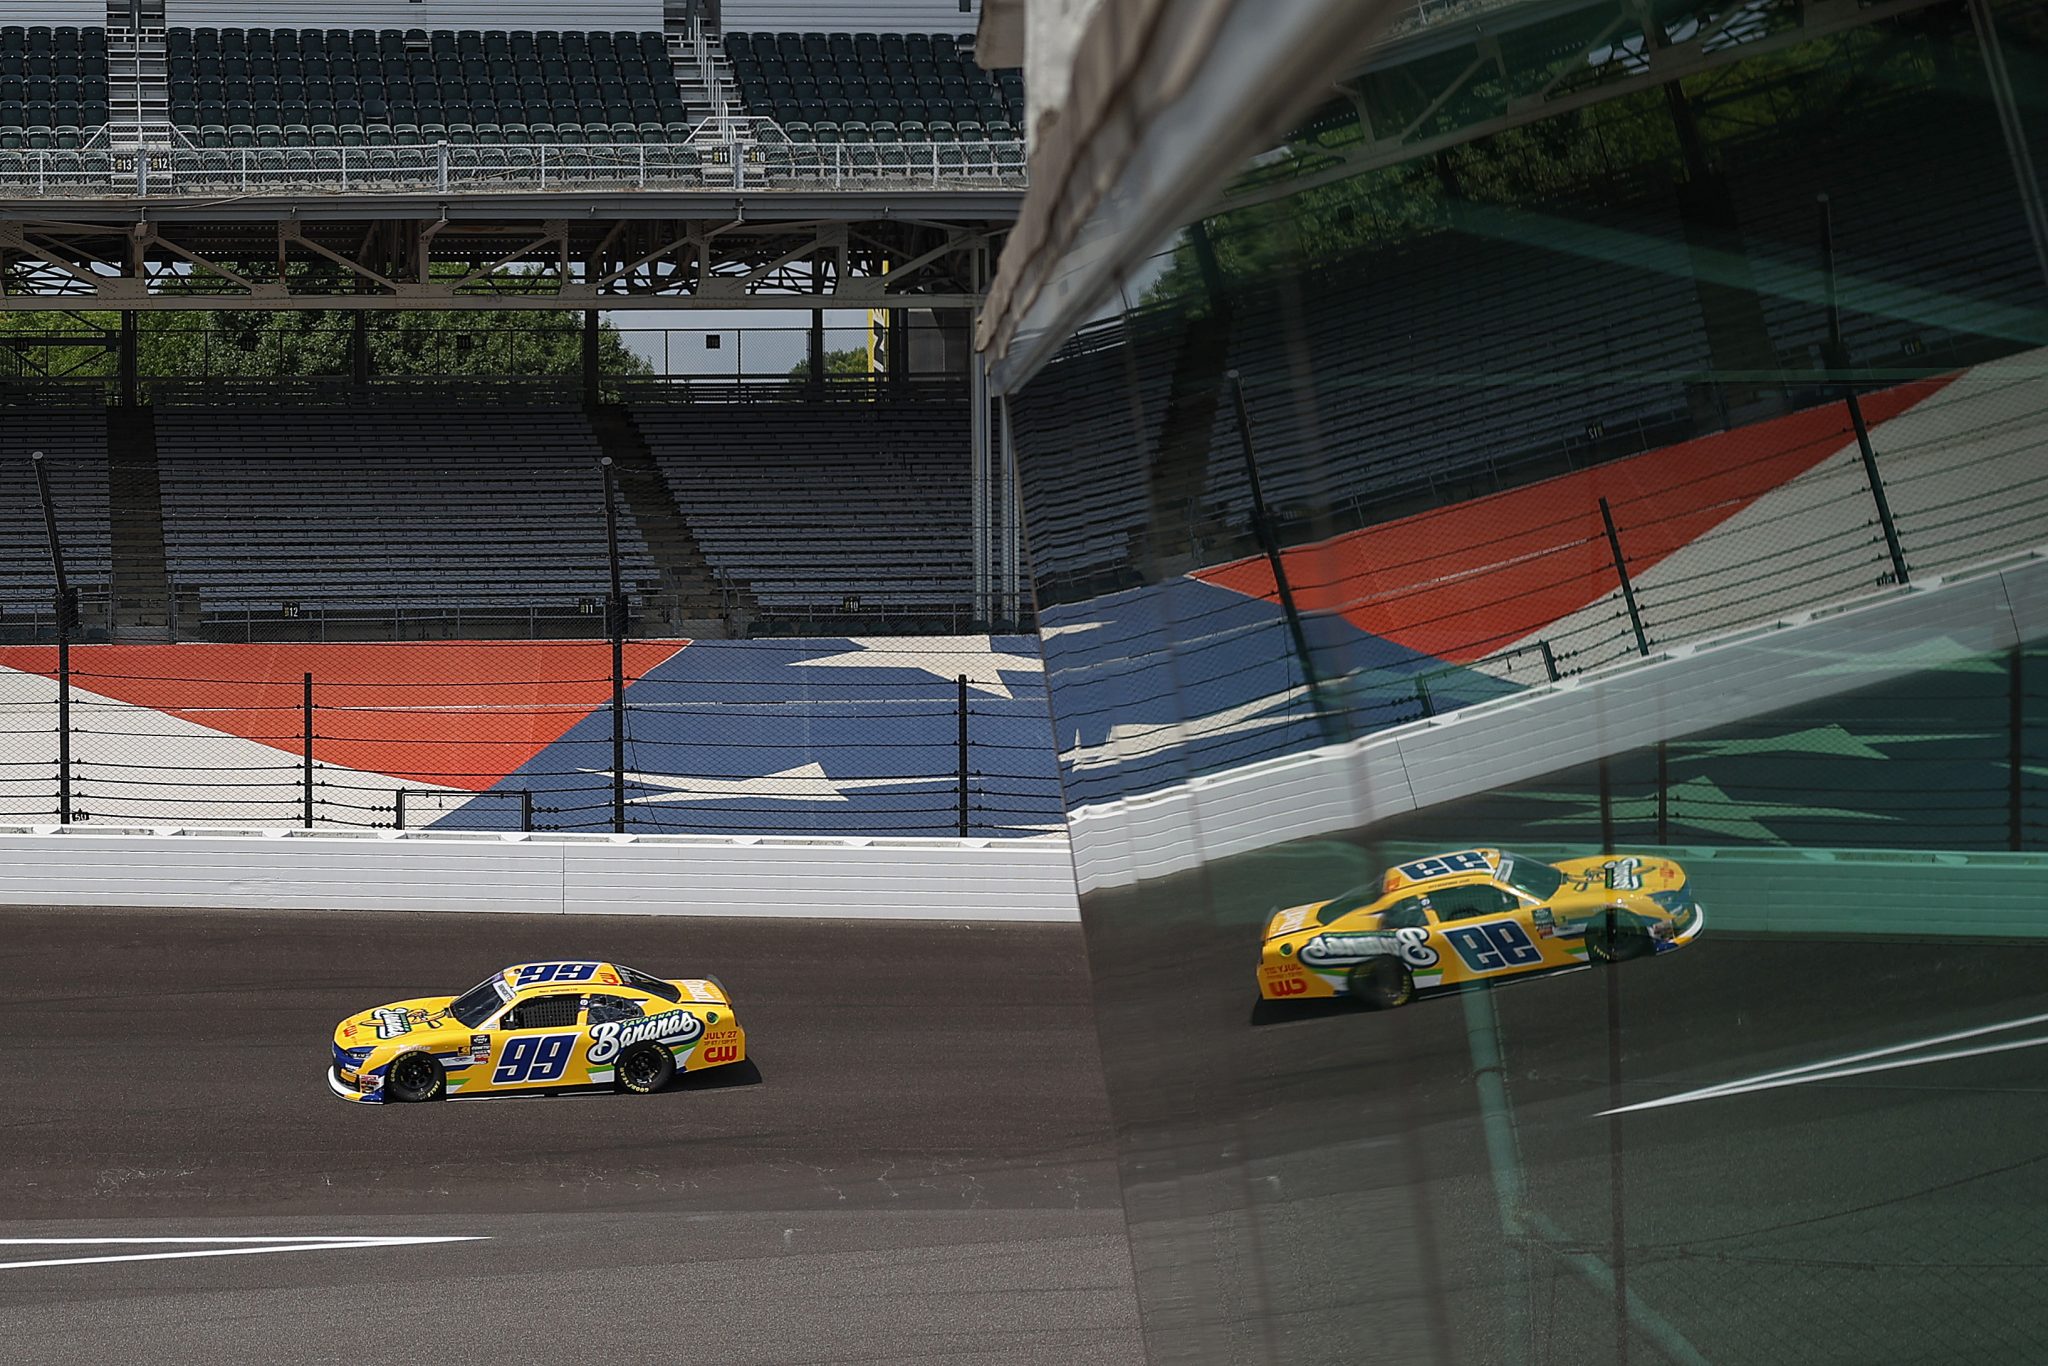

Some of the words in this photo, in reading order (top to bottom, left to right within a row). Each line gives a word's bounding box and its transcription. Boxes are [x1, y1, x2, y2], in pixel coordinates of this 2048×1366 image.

[123, 159, 132, 170] 13
[159, 158, 168, 169] 12
[756, 151, 766, 162] 10
[516, 963, 598, 986] 99
[622, 1011, 680, 1028] SAVANNAH
[586, 1012, 703, 1063] Bananas
[704, 1032, 726, 1040] JULY
[727, 1031, 737, 1039] 27
[491, 1032, 582, 1085] 99
[704, 1046, 738, 1063] CW
